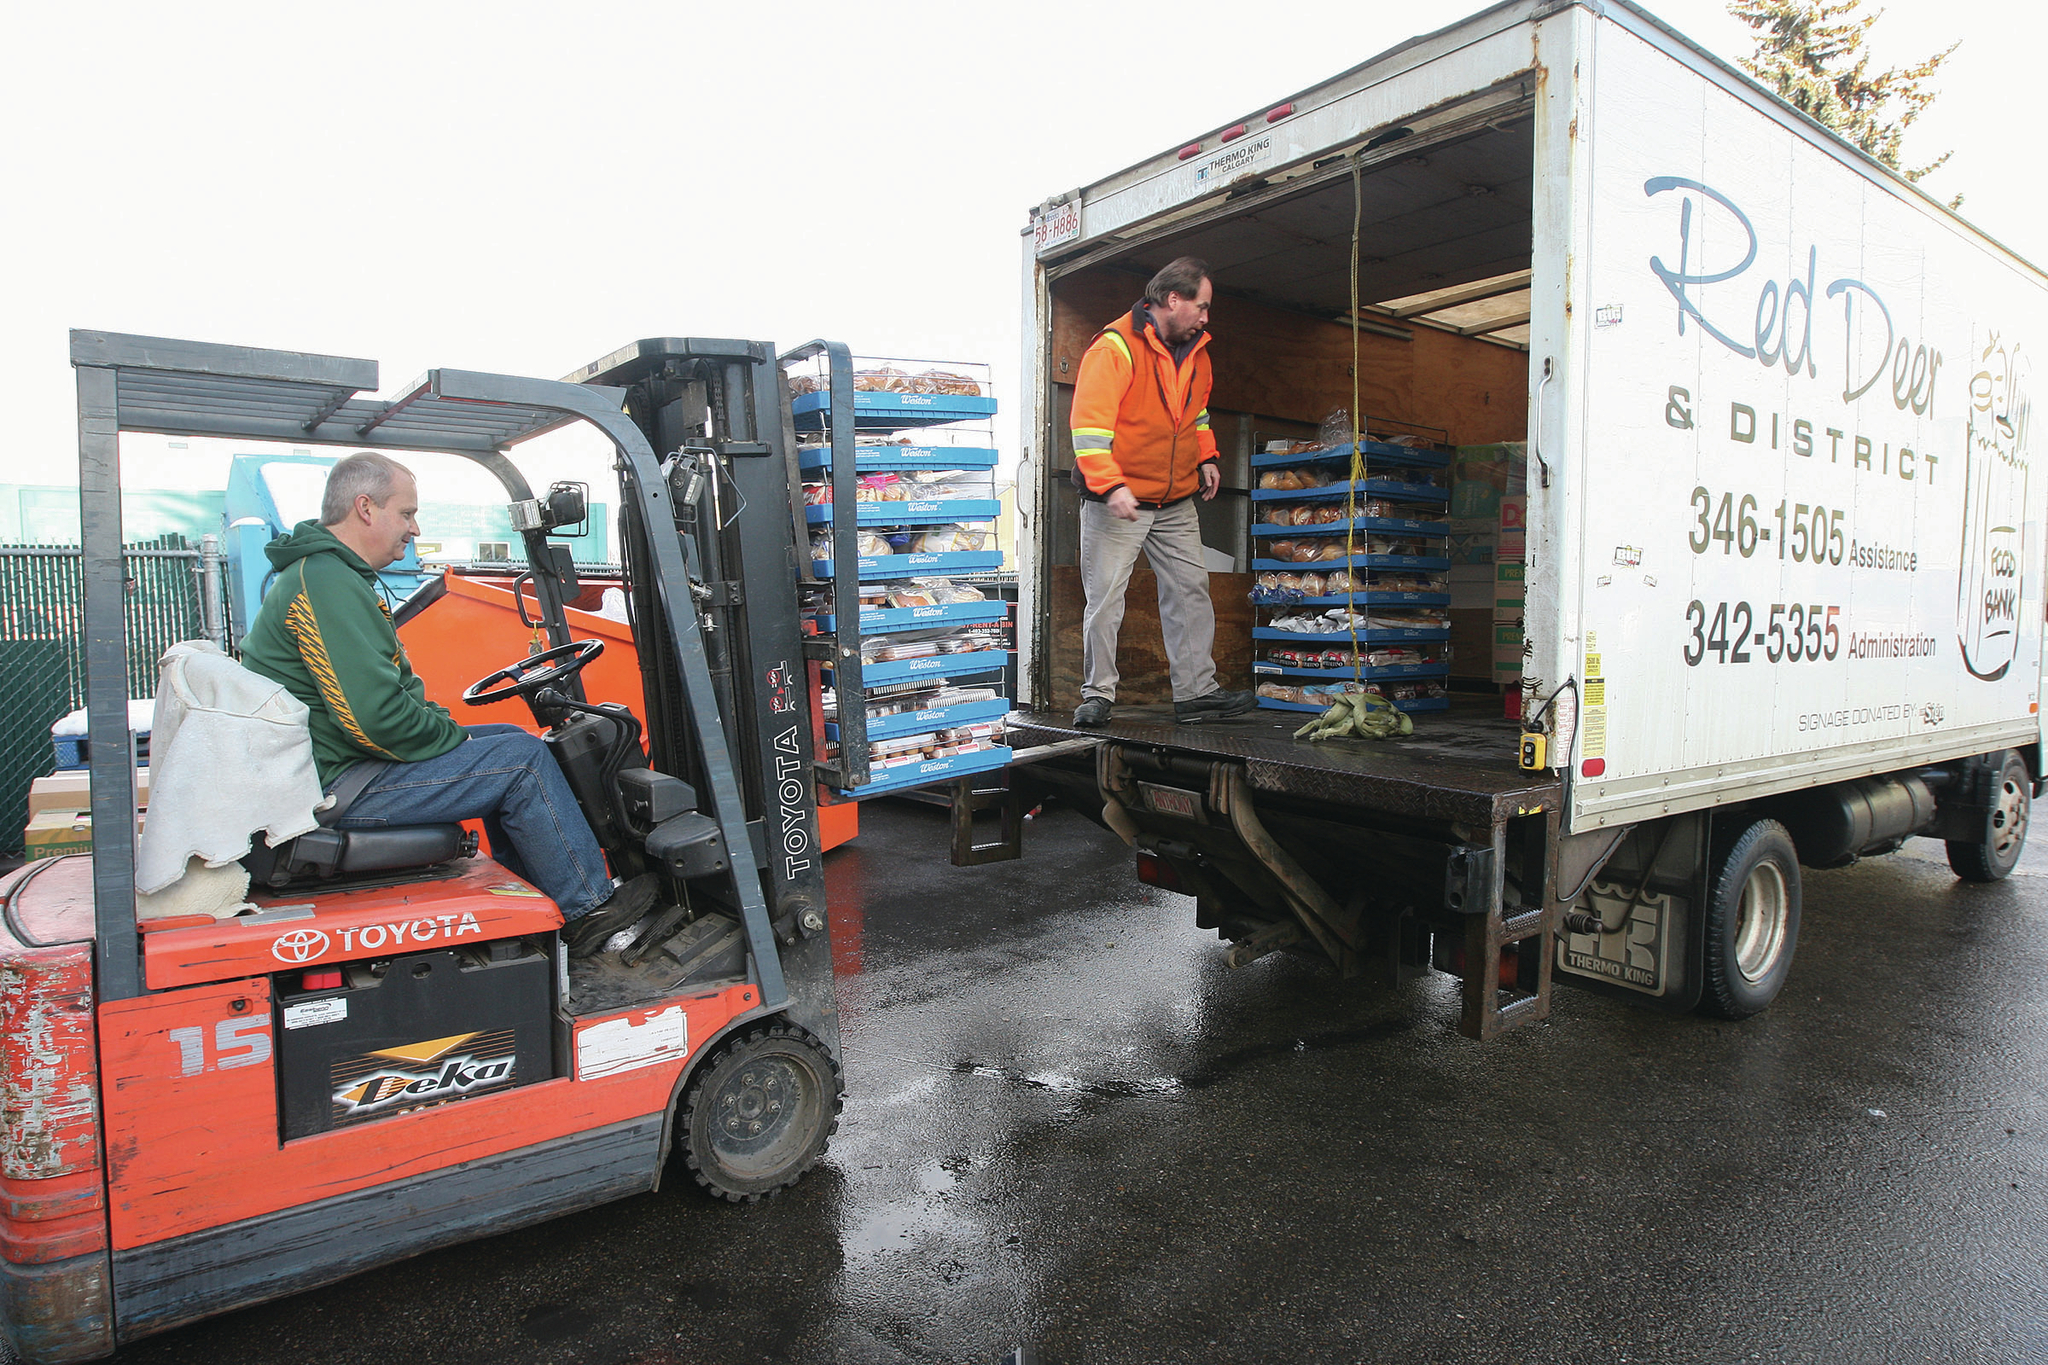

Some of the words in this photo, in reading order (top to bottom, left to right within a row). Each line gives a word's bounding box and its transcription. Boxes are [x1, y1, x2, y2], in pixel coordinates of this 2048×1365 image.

[1210, 148, 1247, 170] THERMO
[1247, 138, 1270, 156] KING
[1222, 154, 1255, 173] CALGARY
[1035, 211, 1078, 244] 58-H886
[1644, 176, 1817, 380] Red
[1826, 278, 1943, 421] Deer
[901, 394, 932, 405] Weston
[1665, 385, 1694, 430] &
[1731, 401, 1939, 486] DISTRICT
[900, 447, 932, 457] Weston
[907, 501, 938, 512] Weston
[1688, 485, 1845, 567] 346-1505
[1848, 538, 1917, 572] Assistance
[1991, 546, 2016, 578] FOOD
[913, 606, 943, 618] Weston
[1985, 588, 2015, 625] BANK
[1683, 599, 1841, 667] 342-5355
[1847, 632, 1936, 659] Administration
[909, 659, 941, 670] Weston
[915, 709, 946, 721] Weston
[1798, 710, 1850, 732] SIGNAGE
[1851, 705, 1902, 725] DONATED
[1903, 703, 1918, 719] BY:
[919, 761, 950, 773] Weston
[774, 725, 810, 880] TOYOTA
[336, 912, 482, 952] TOYOTA
[1569, 953, 1620, 976] THERMO
[1624, 967, 1653, 986] KING
[352, 1061, 509, 1107] Deka
